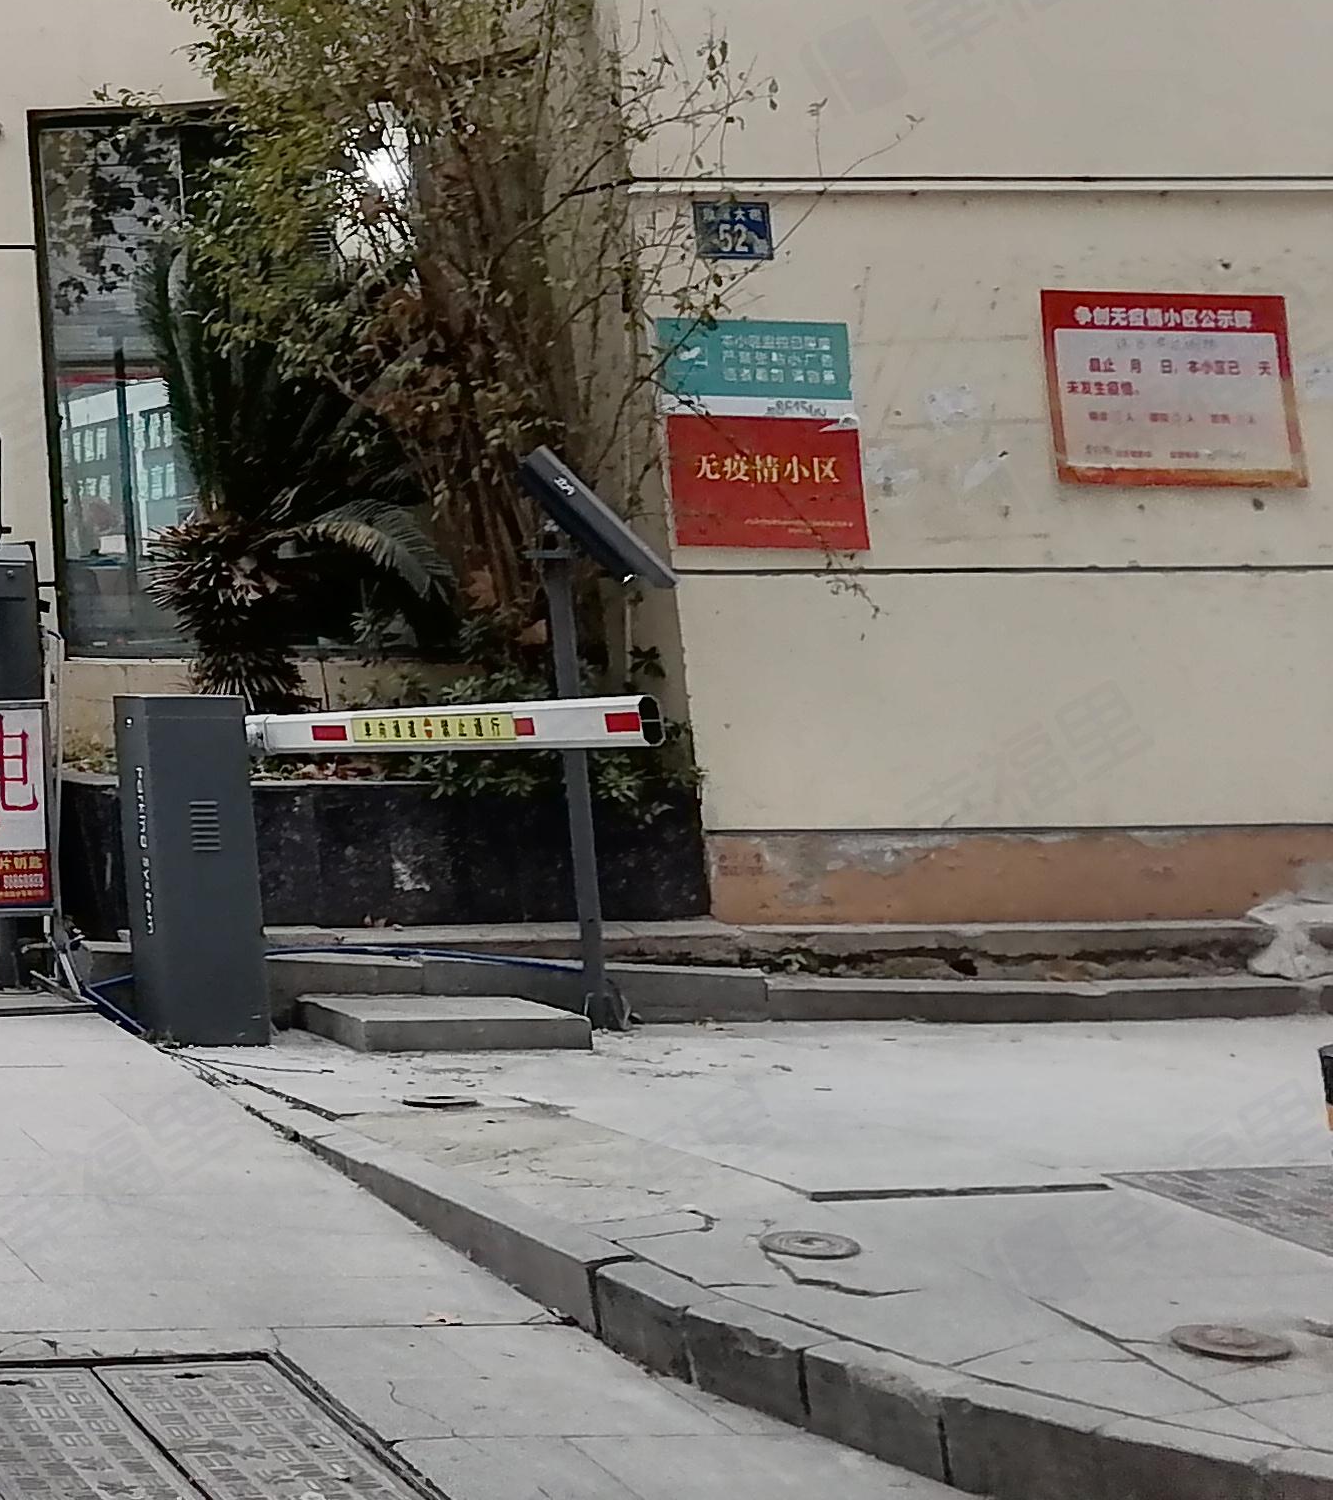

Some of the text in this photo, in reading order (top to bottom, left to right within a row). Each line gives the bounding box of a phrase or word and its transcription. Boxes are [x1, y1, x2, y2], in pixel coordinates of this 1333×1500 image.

[718, 223, 749, 253] 52
[694, 452, 841, 484] 无疫情小区
